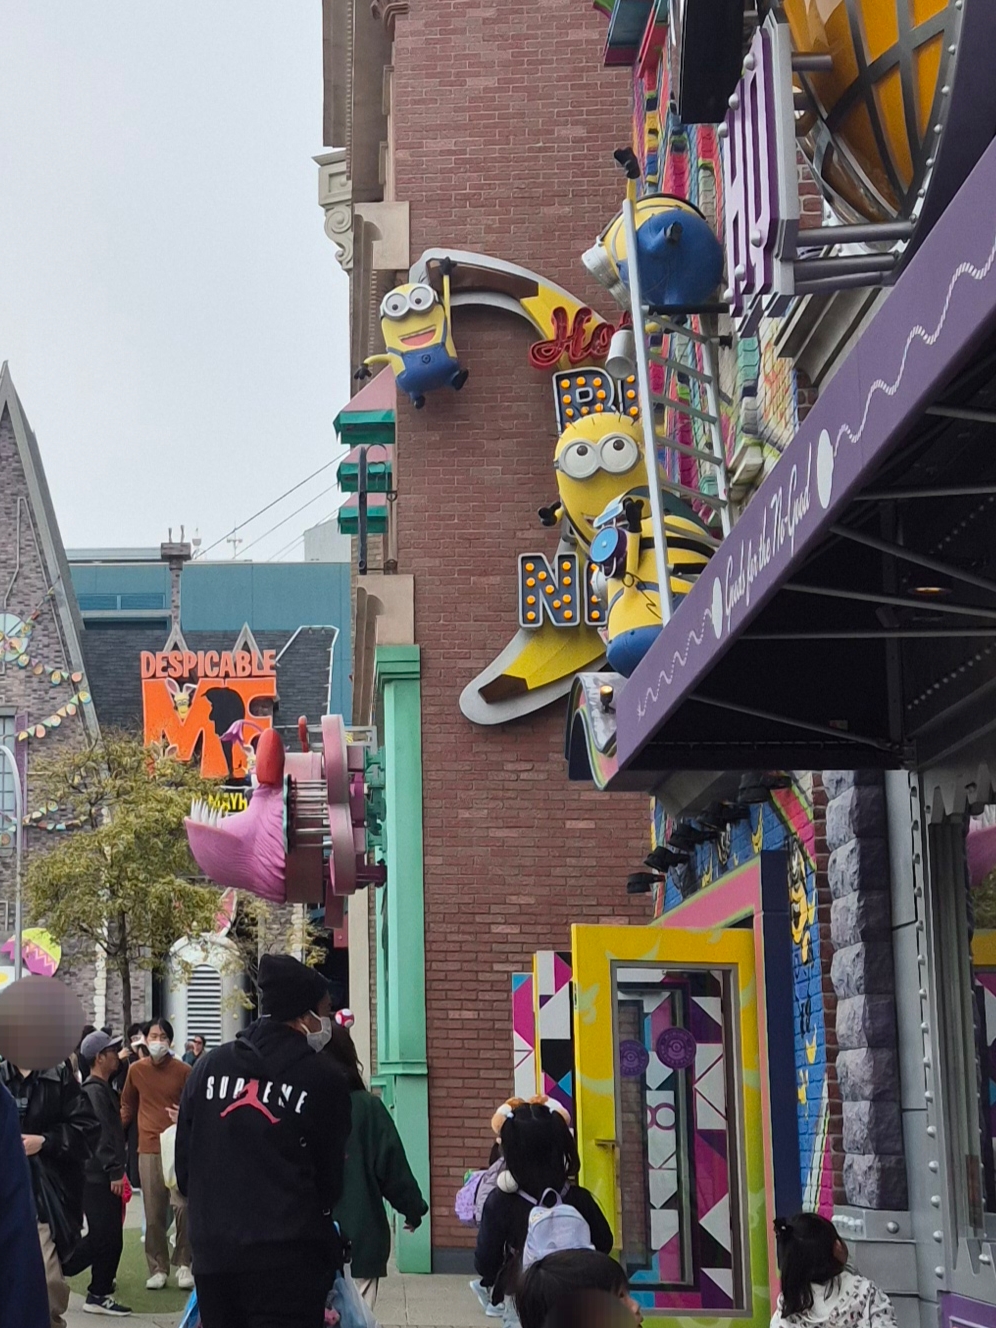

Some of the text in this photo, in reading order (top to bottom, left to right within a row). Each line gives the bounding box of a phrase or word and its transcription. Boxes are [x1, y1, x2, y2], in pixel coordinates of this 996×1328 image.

[745, 538, 759, 608] for
[758, 505, 771, 572] the
[140, 649, 277, 679] DESPICABLE
[141, 676, 277, 780] ME
[205, 1075, 308, 1114] SUPEME
